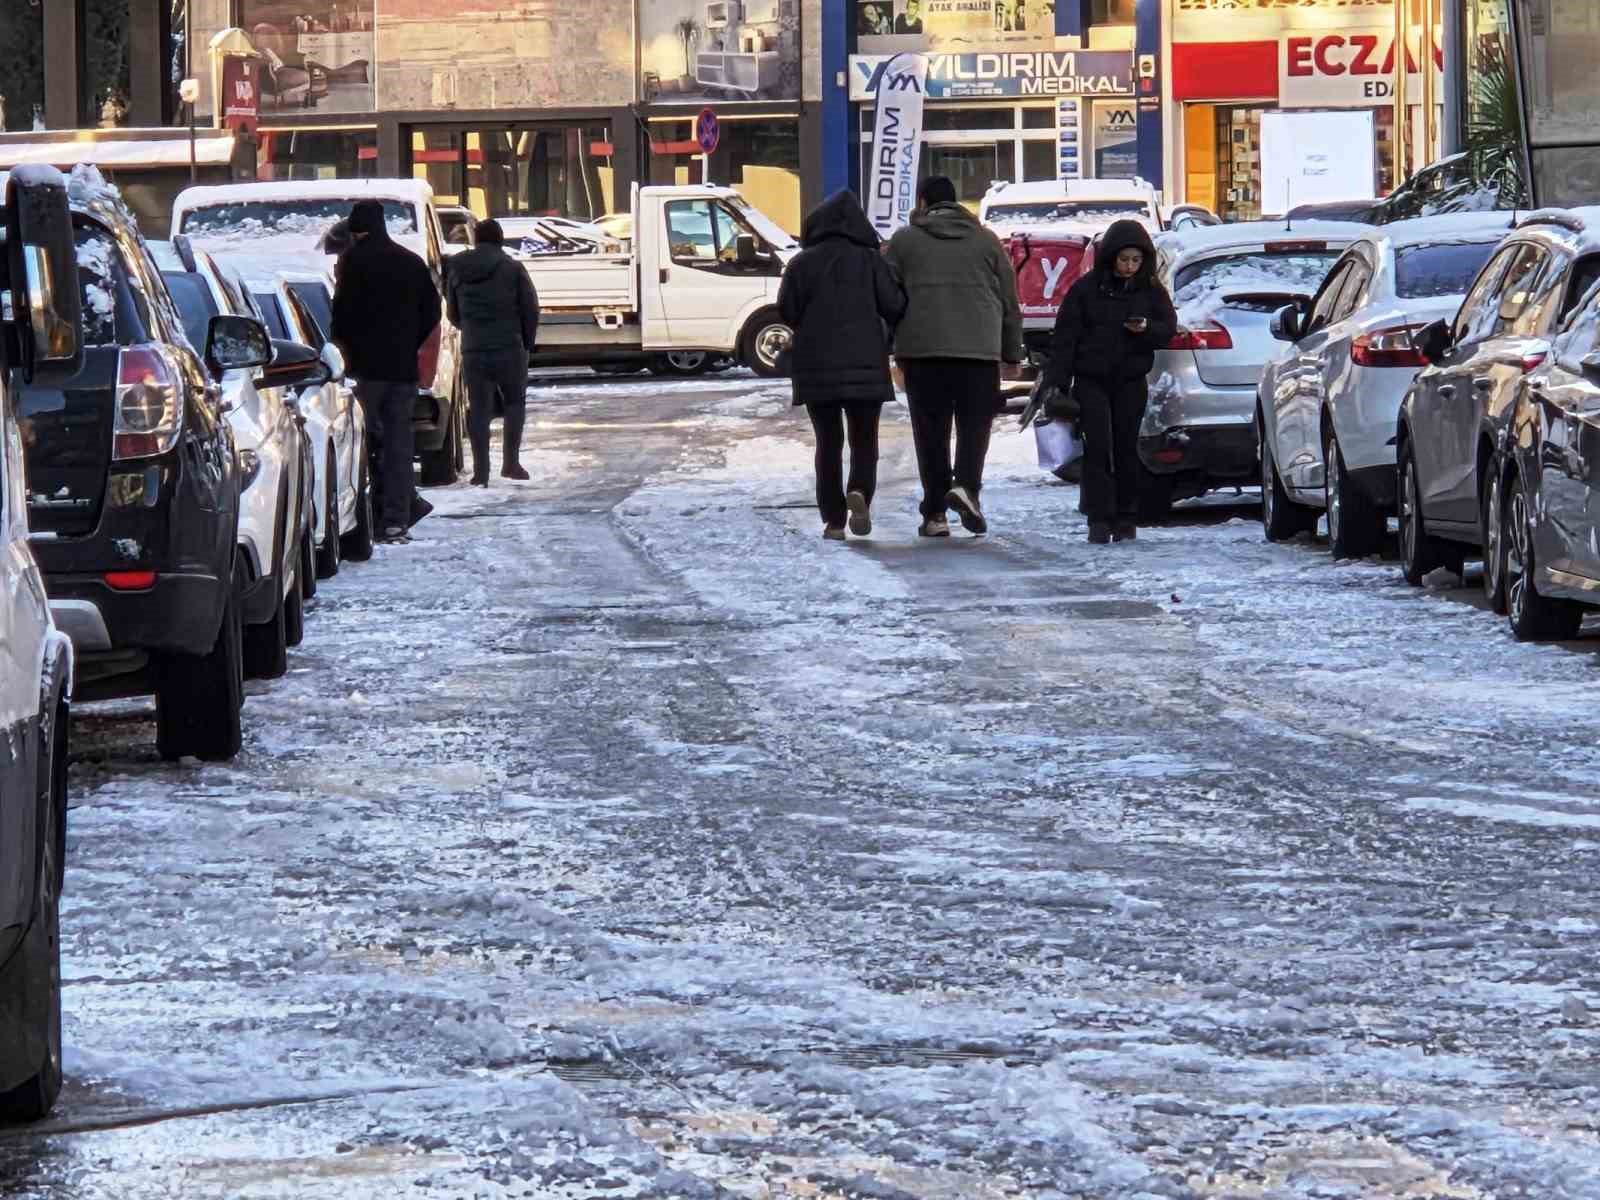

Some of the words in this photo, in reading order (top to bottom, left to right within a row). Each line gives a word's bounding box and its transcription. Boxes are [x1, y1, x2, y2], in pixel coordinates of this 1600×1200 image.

[928, 52, 1076, 79] YILDIRIM
[1021, 75, 1128, 94] MEDİKAL
[1364, 81, 1393, 97] ED
[875, 107, 901, 229] ILDIRIM
[1041, 256, 1069, 299] Y
